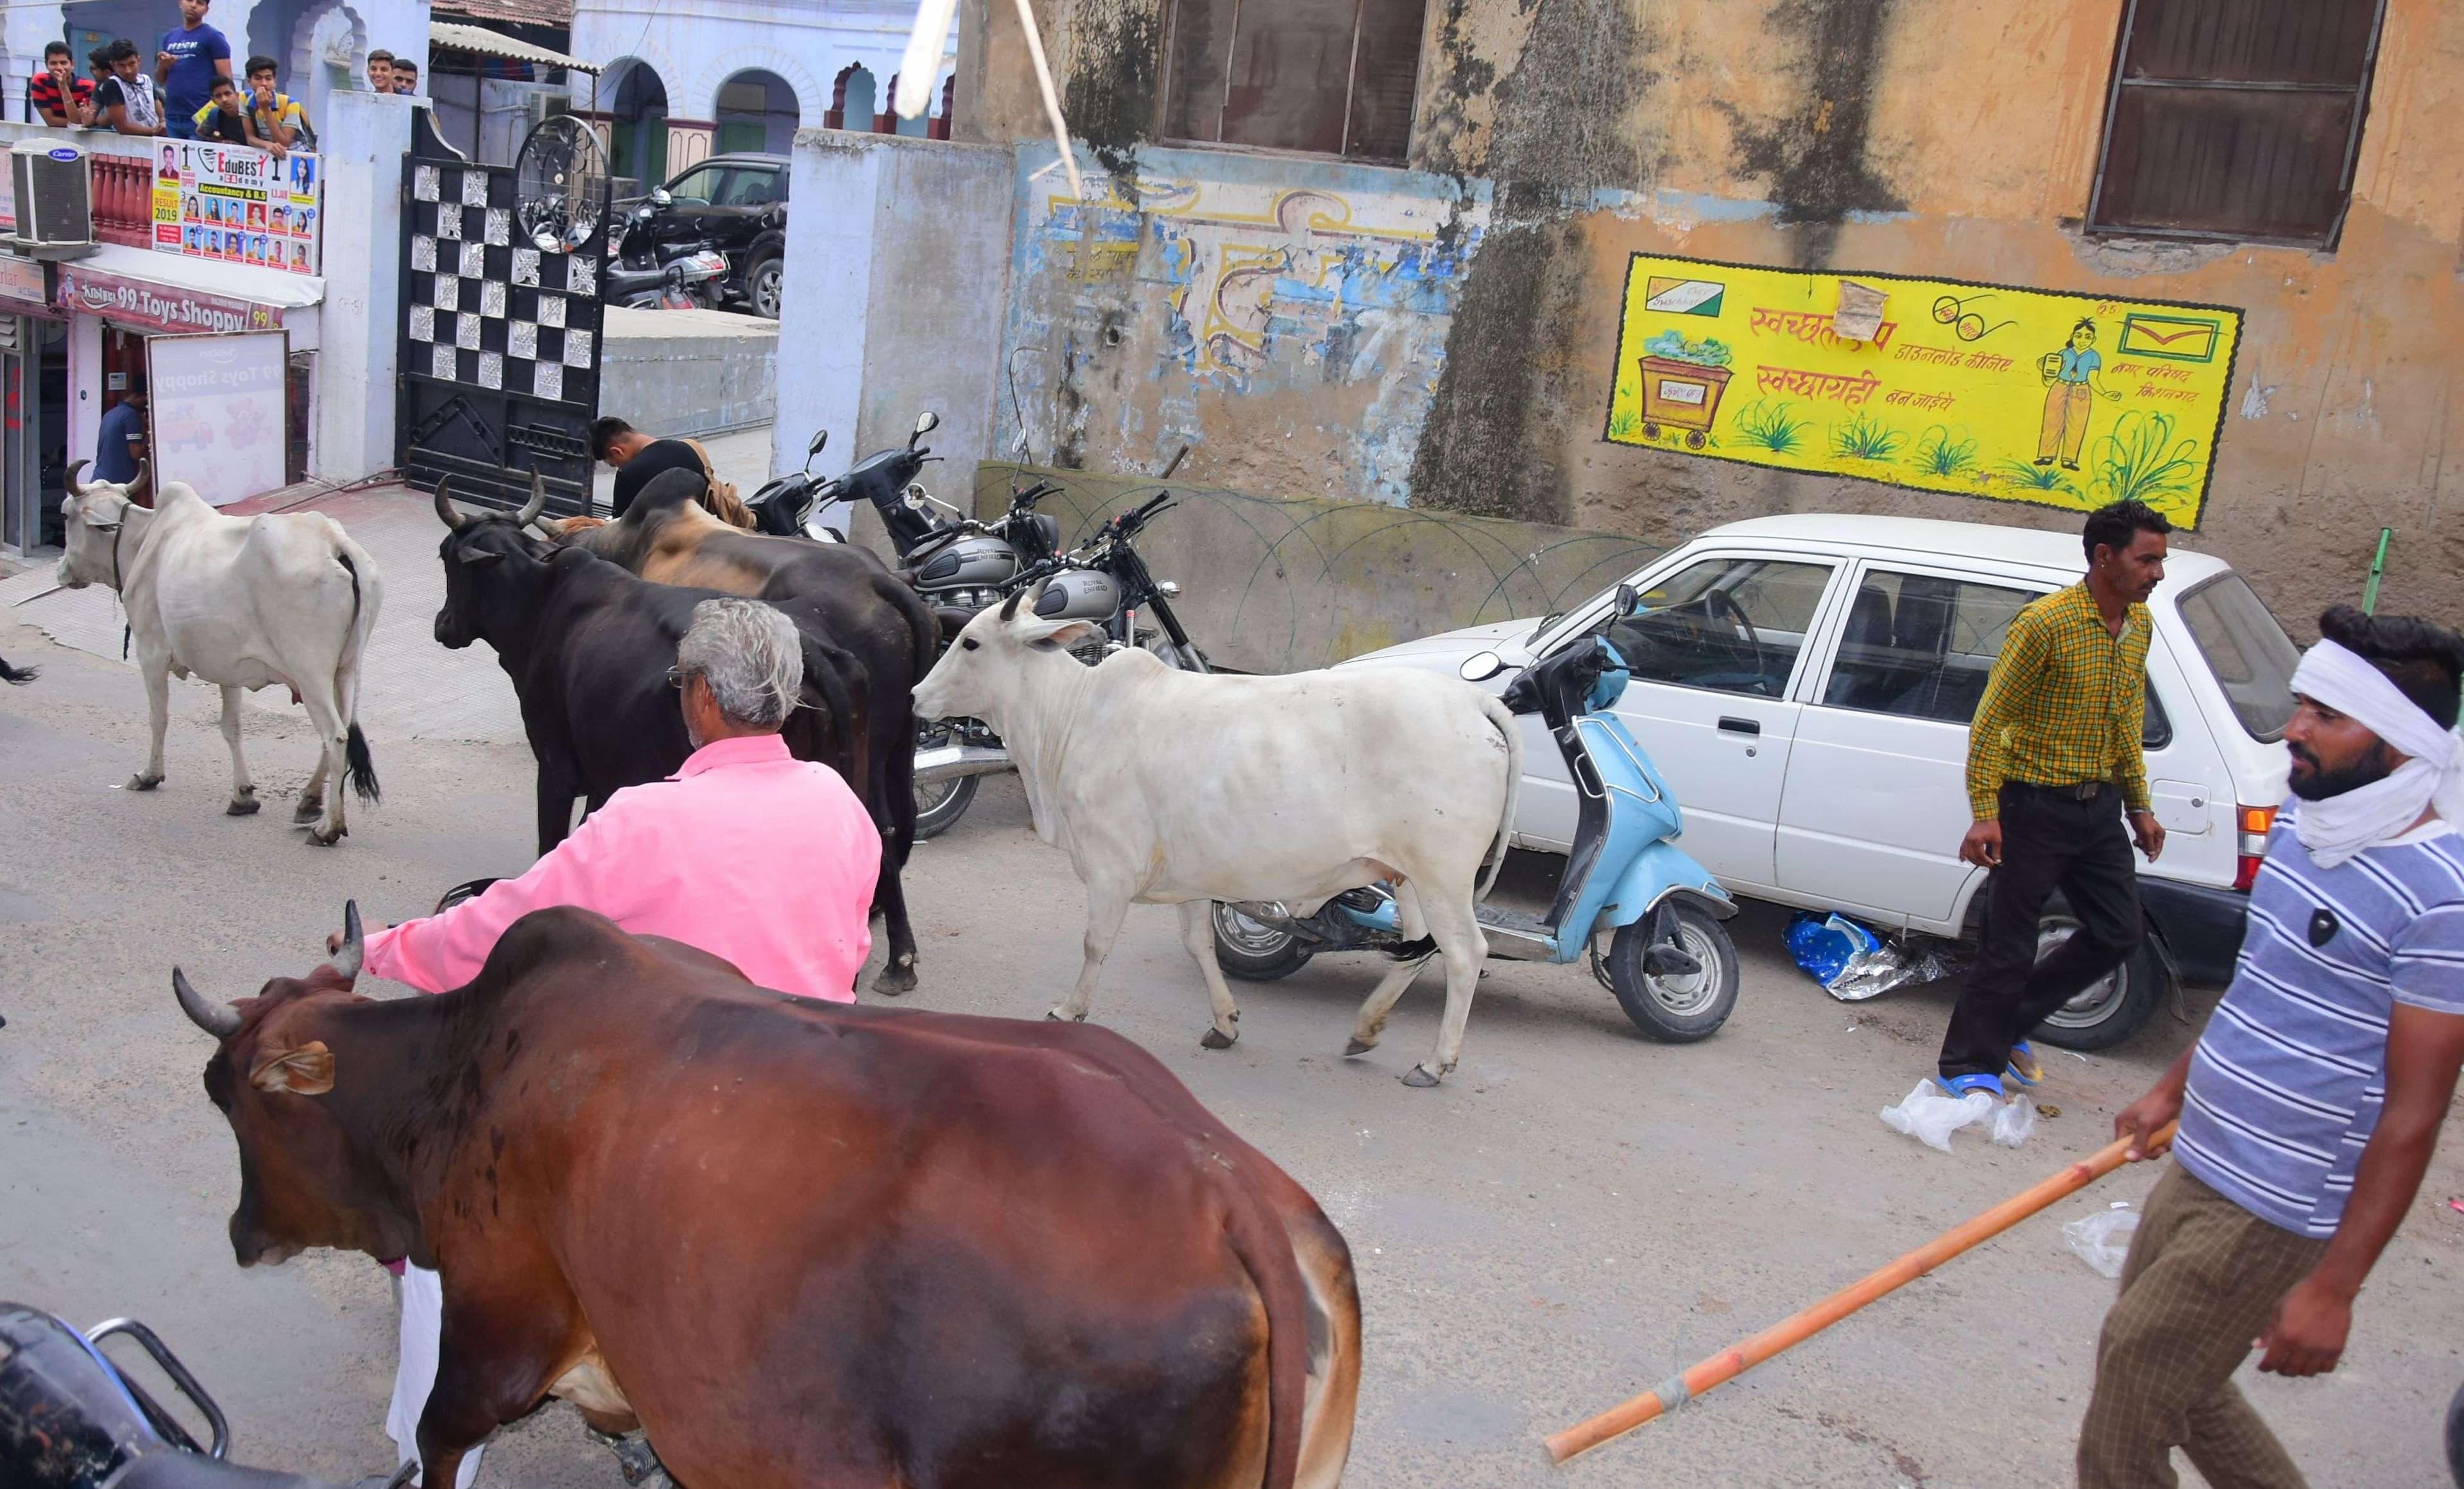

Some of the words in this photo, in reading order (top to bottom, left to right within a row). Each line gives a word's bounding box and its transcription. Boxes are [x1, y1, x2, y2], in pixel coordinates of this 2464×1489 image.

[200, 184, 244, 199] Accountancy
[246, 189, 252, 198] &
[155, 198, 178, 208] RESULT
[155, 208, 177, 221] 2019
[117, 286, 137, 311] 99
[140, 291, 179, 325] Toys
[182, 299, 244, 332] Shoppy
[2098, 305, 2117, 315] 25
[253, 311, 268, 328] 99
[1894, 343, 1966, 366] डाउनलोड
[2110, 362, 2143, 379] नगर
[1886, 389, 1915, 407] बन
[1084, 585, 1108, 594] ENFIELD
